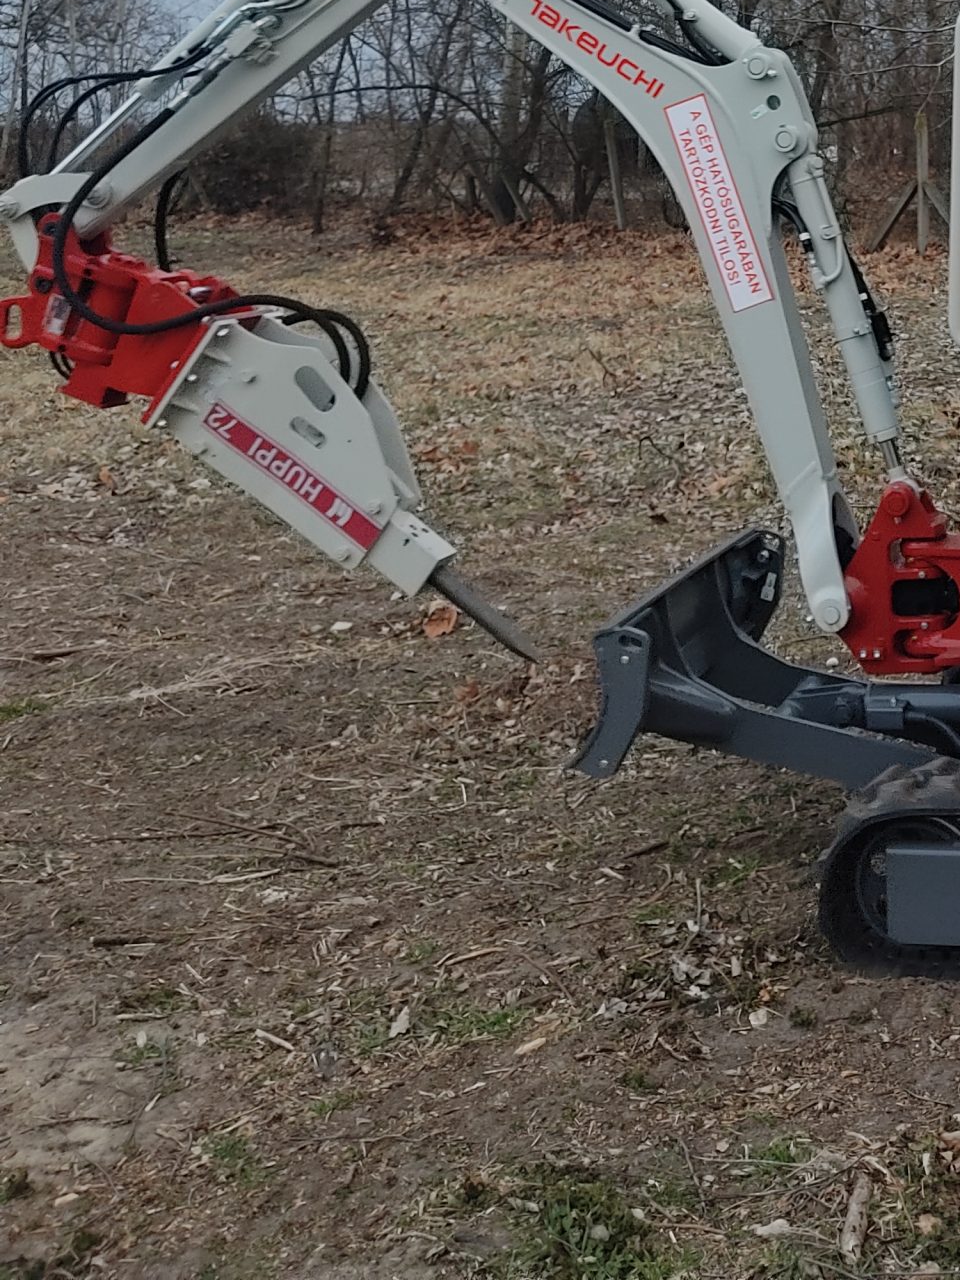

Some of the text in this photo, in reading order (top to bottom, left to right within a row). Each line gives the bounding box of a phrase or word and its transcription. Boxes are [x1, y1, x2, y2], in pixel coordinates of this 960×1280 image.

[679, 128, 723, 234] TARTÓZKODNI
[689, 111, 762, 294] A GÉP HATÓSUGARÁBAN
[207, 406, 323, 503] HUPPI 72
